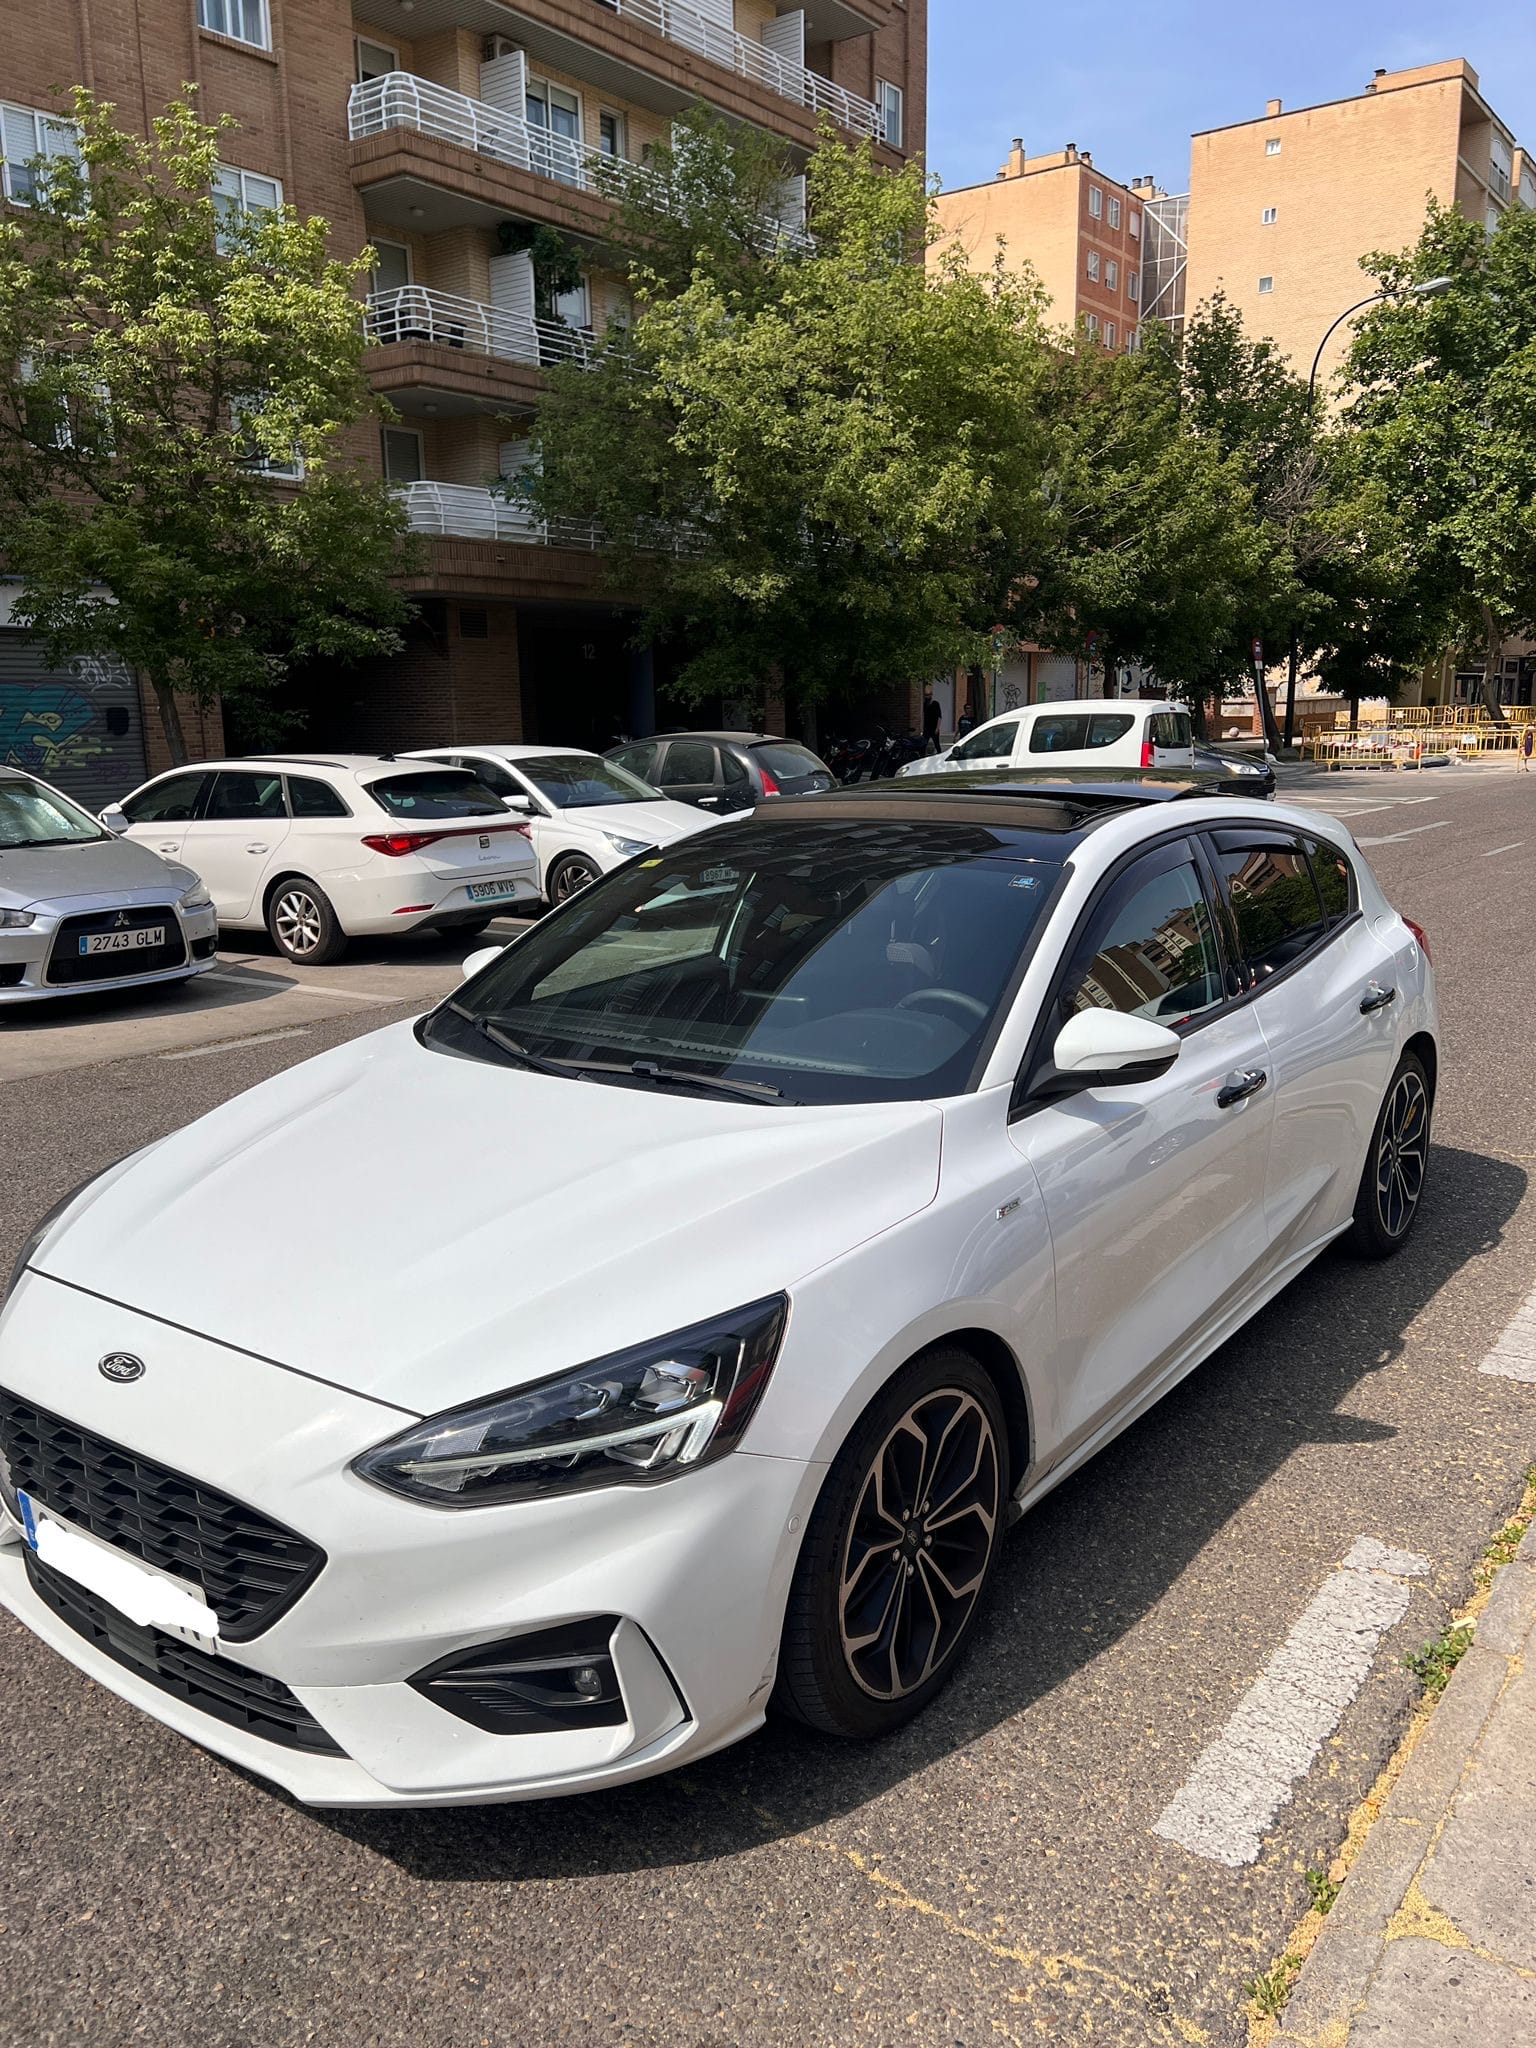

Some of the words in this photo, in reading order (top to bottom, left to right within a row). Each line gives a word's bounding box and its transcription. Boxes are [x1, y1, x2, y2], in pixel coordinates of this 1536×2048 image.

[581, 643, 596, 659] 12
[705, 869, 723, 880] 8967
[473, 881, 496, 897] 5906
[497, 880, 515, 893] MVB
[93, 934, 129, 951] 2743
[136, 929, 162, 946] GLM
[106, 1356, 136, 1376] Ford
